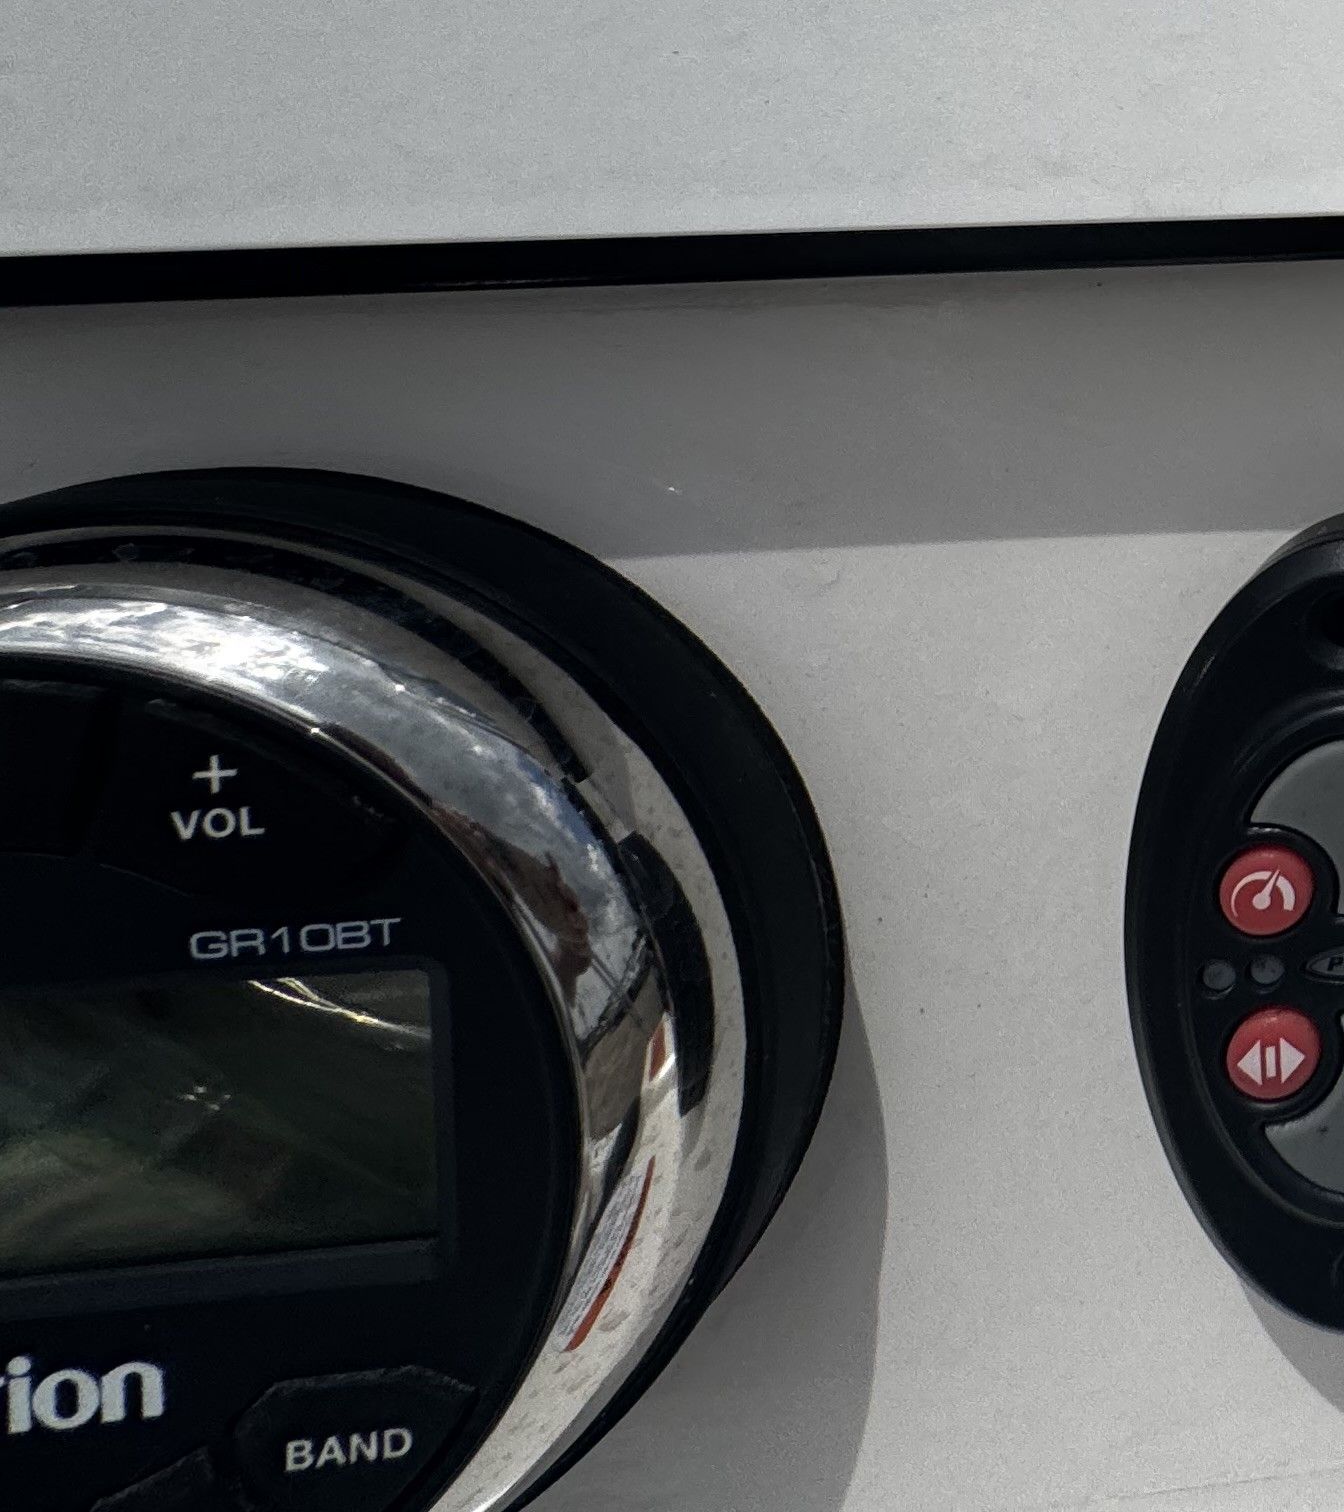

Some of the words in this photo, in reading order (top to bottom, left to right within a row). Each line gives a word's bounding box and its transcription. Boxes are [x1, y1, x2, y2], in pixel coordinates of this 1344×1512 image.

[171, 807, 266, 840] VOL
[189, 918, 402, 959] GR10BT
[0, 1355, 165, 1435] ion
[285, 1427, 413, 1473] BAND
